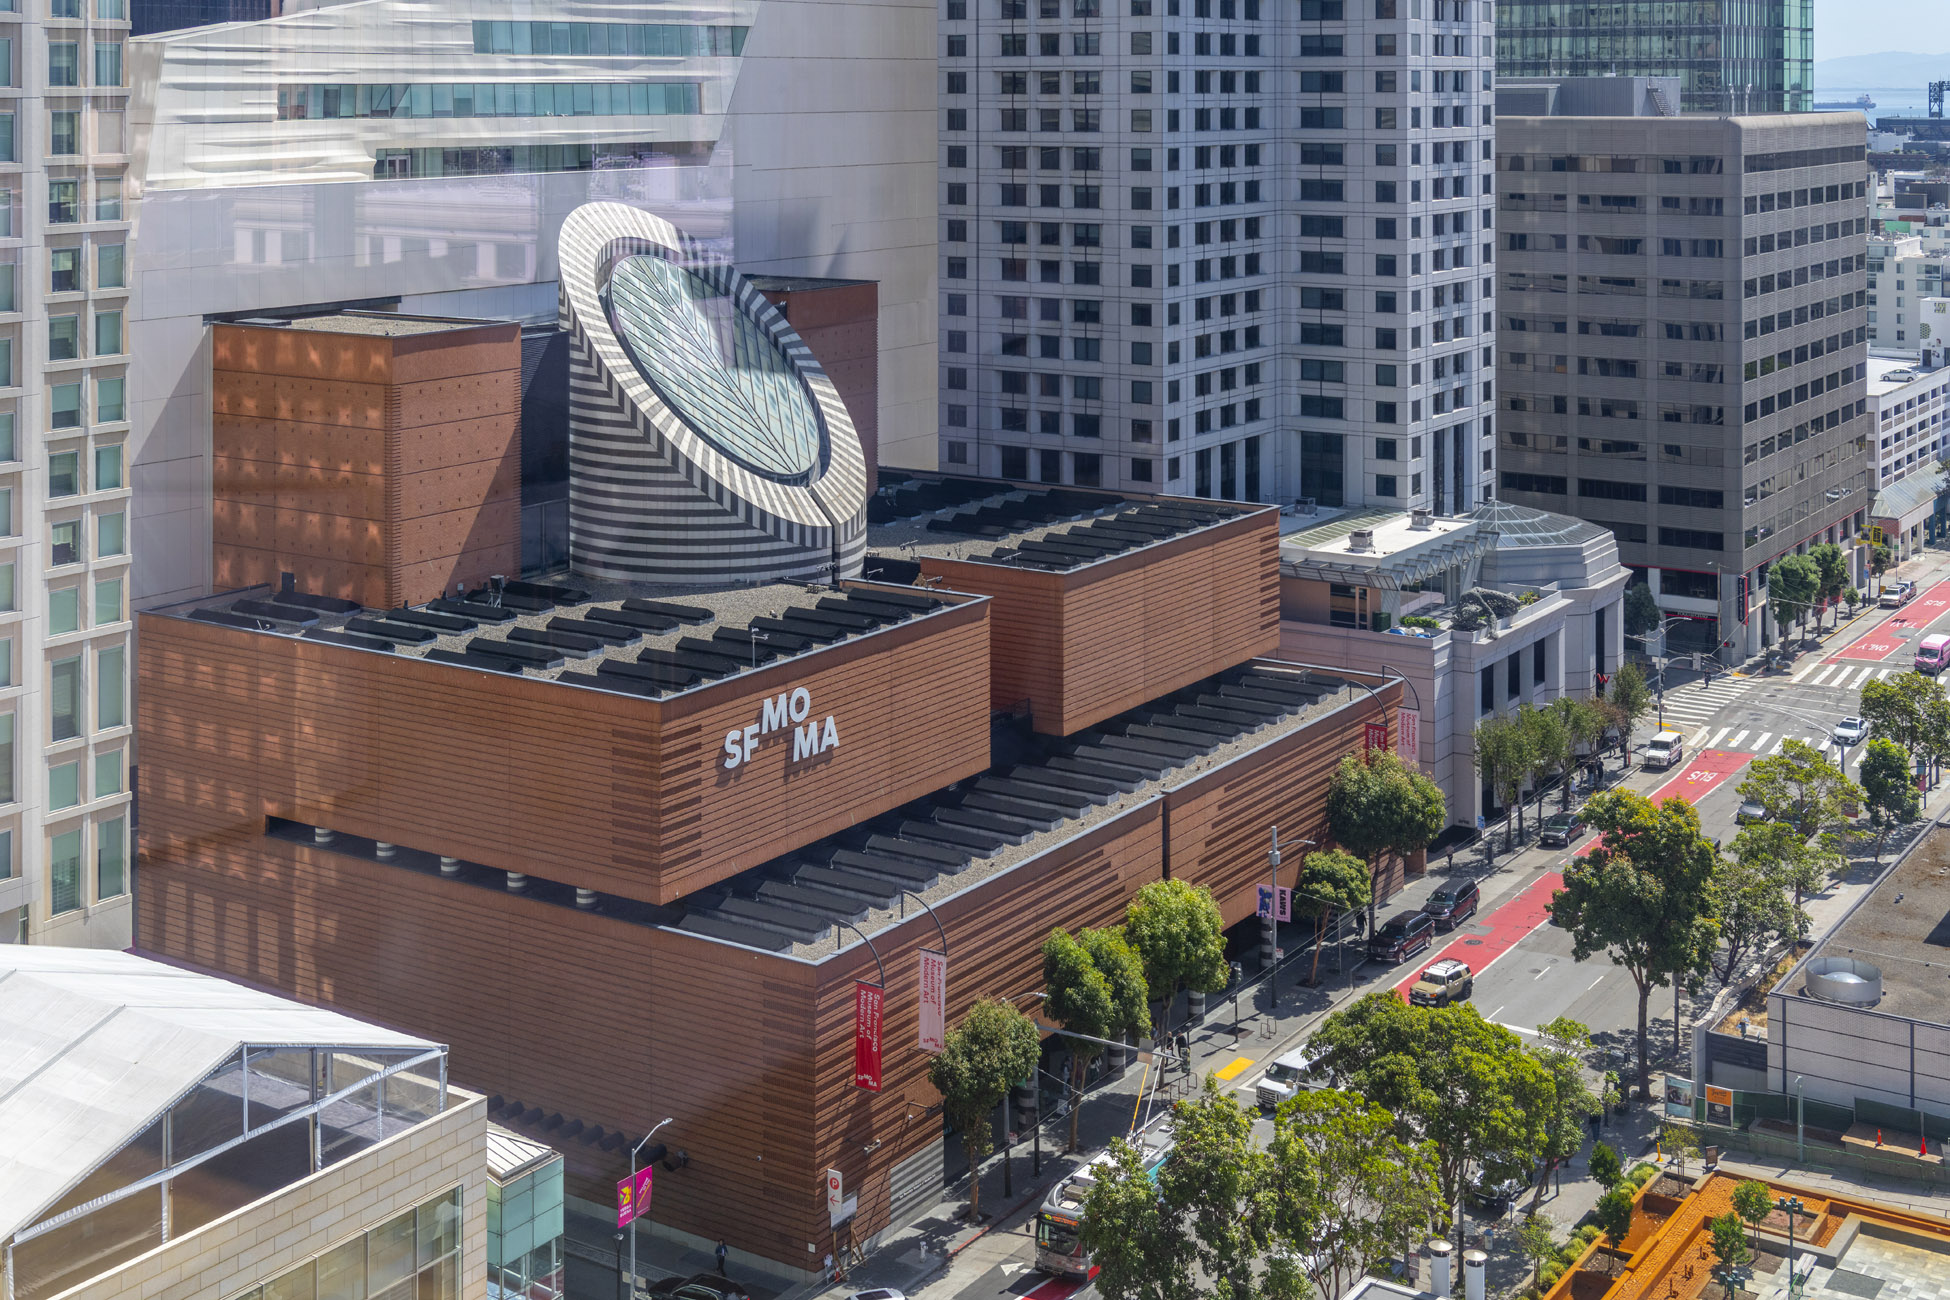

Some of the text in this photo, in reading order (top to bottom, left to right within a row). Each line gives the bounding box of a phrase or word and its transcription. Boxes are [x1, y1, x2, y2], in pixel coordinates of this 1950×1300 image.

[1856, 643, 1889, 652] ONLY
[1597, 673, 1610, 684] W
[1686, 771, 1718, 782] BUS
[930, 995, 936, 1005] of
[866, 1029, 872, 1040] of
